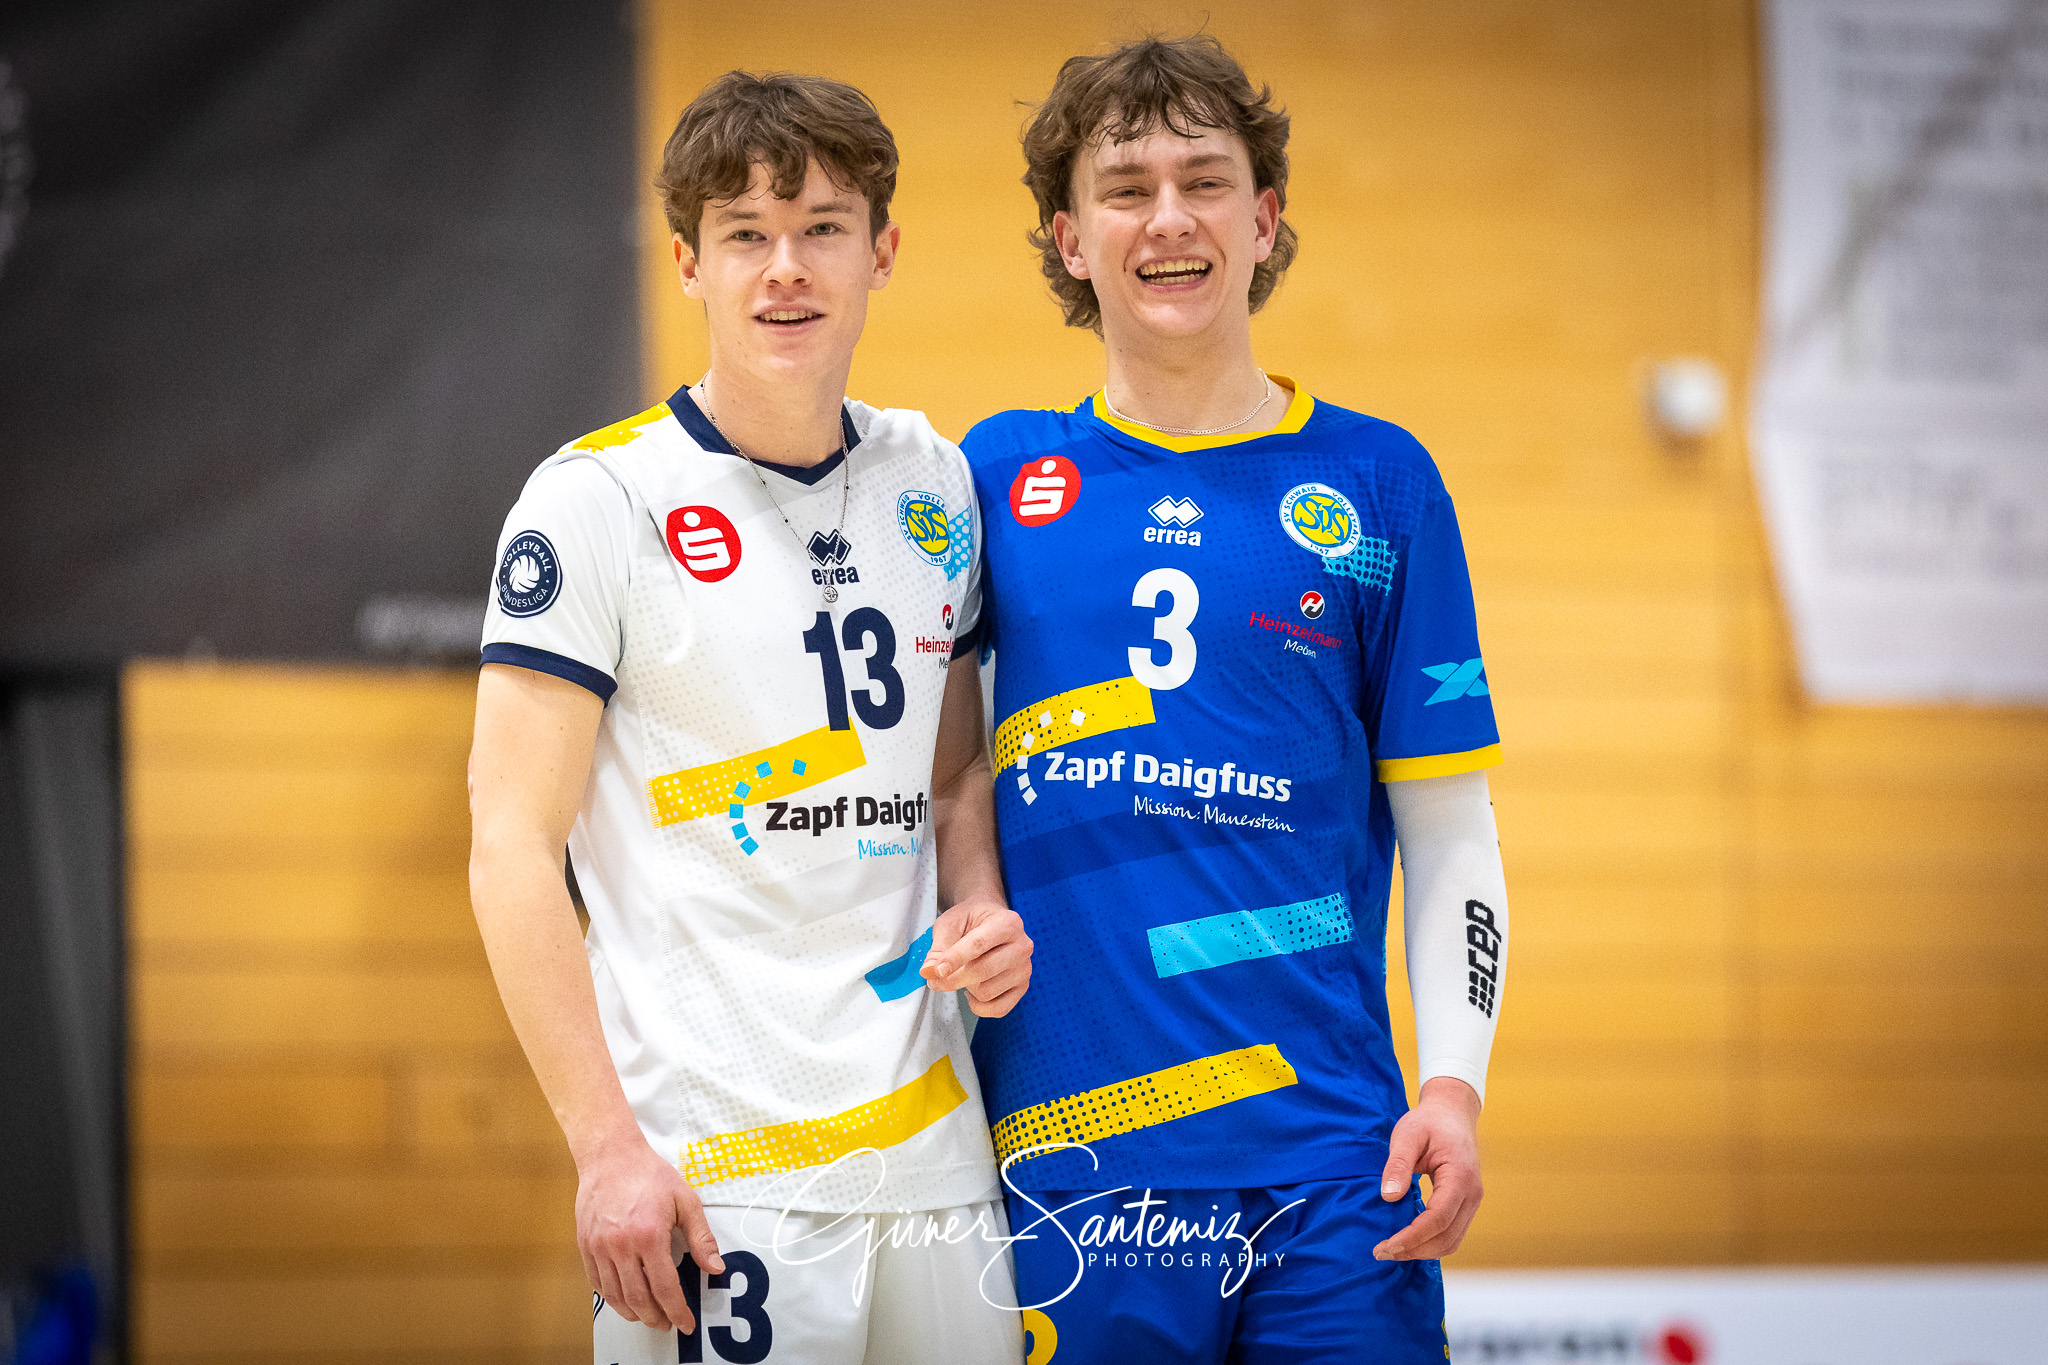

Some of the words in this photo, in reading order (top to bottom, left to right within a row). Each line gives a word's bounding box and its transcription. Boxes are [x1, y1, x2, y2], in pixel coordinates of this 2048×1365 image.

[1284, 512, 1291, 522] SV
[1143, 527, 1201, 547] errea
[503, 541, 552, 572] VOLLEYBALL
[502, 584, 548, 607] BUNDESLIGA
[916, 636, 955, 653] Heinzel
[1127, 567, 1201, 691] 3
[1249, 611, 1342, 649] Heinzelmann
[803, 607, 905, 731] 13
[1045, 751, 1126, 788] Zapf
[1133, 754, 1292, 802] Daigfuss
[766, 796, 848, 837] Zapf
[677, 1250, 773, 1364] 13
